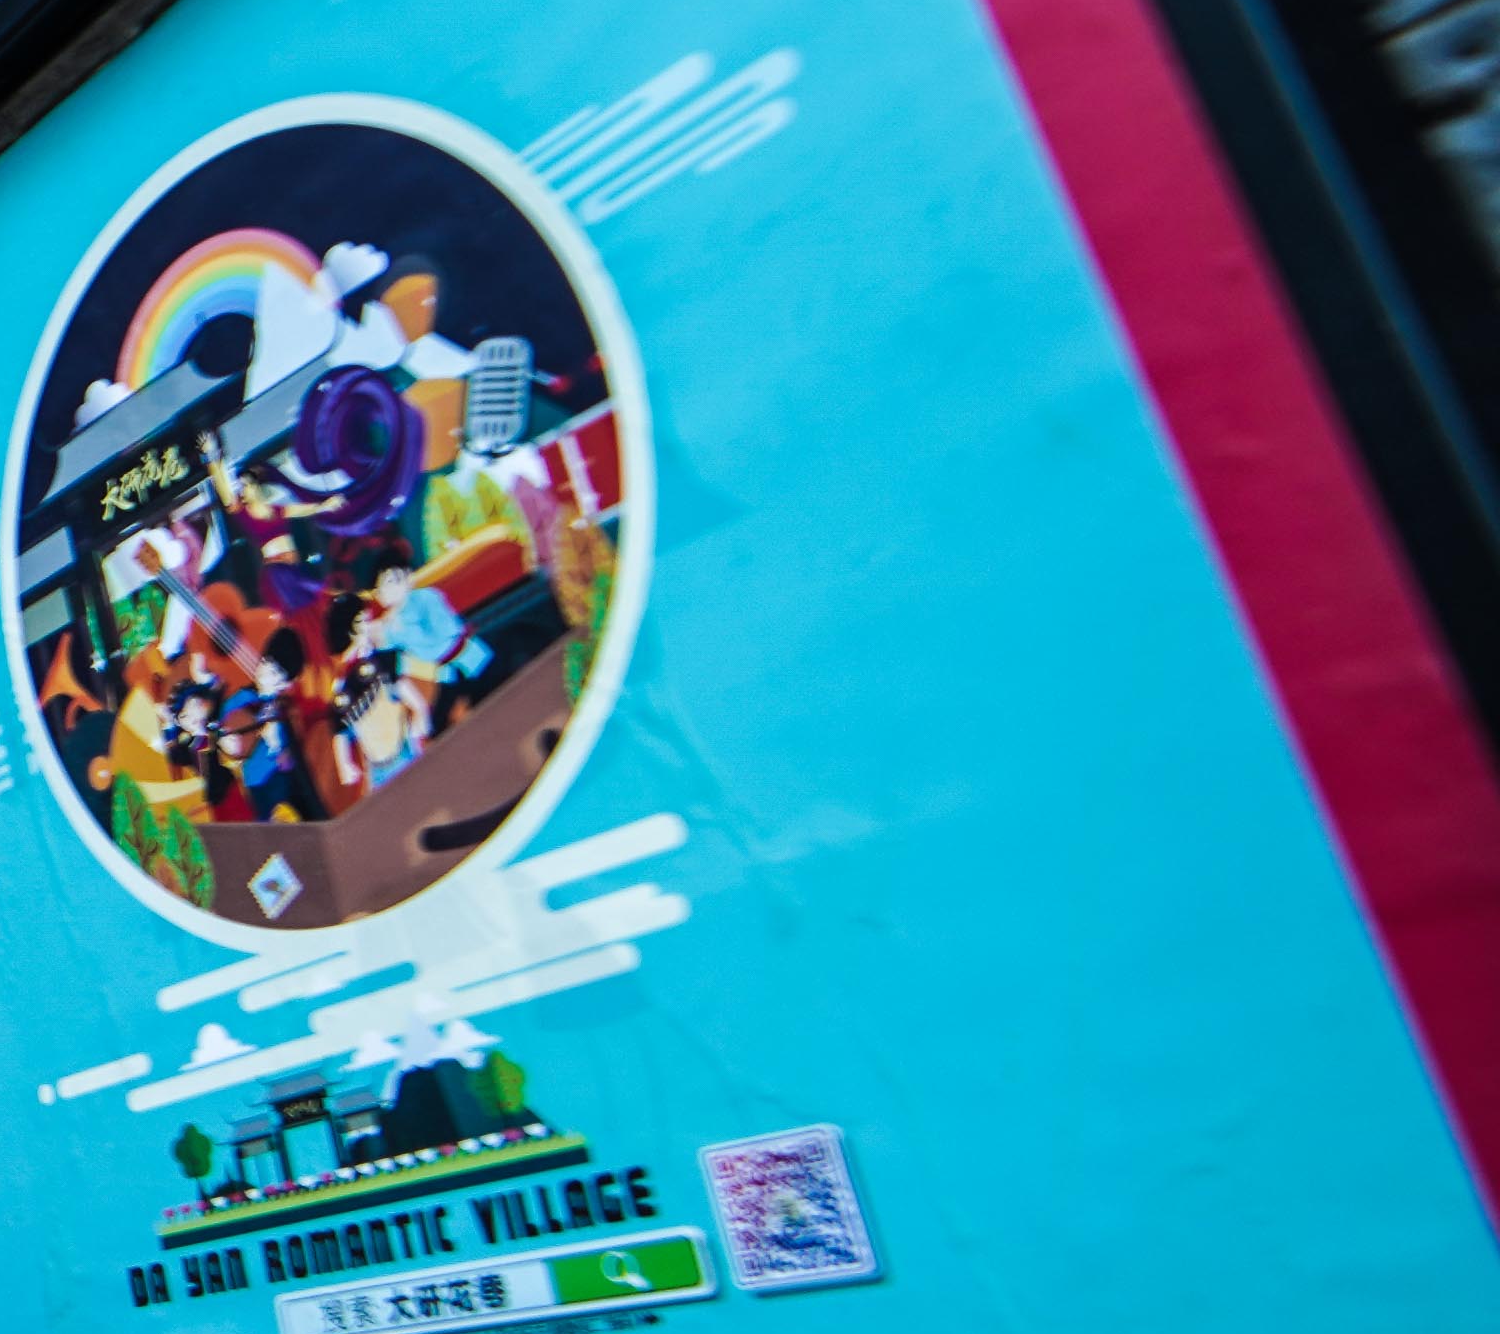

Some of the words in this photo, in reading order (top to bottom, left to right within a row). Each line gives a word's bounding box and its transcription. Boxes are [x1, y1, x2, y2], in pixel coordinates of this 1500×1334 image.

[127, 1264, 171, 1307] DA
[182, 1247, 249, 1298] YAN
[262, 1207, 454, 1283] ROMANTIC
[470, 1166, 658, 1245] VILLAGE
